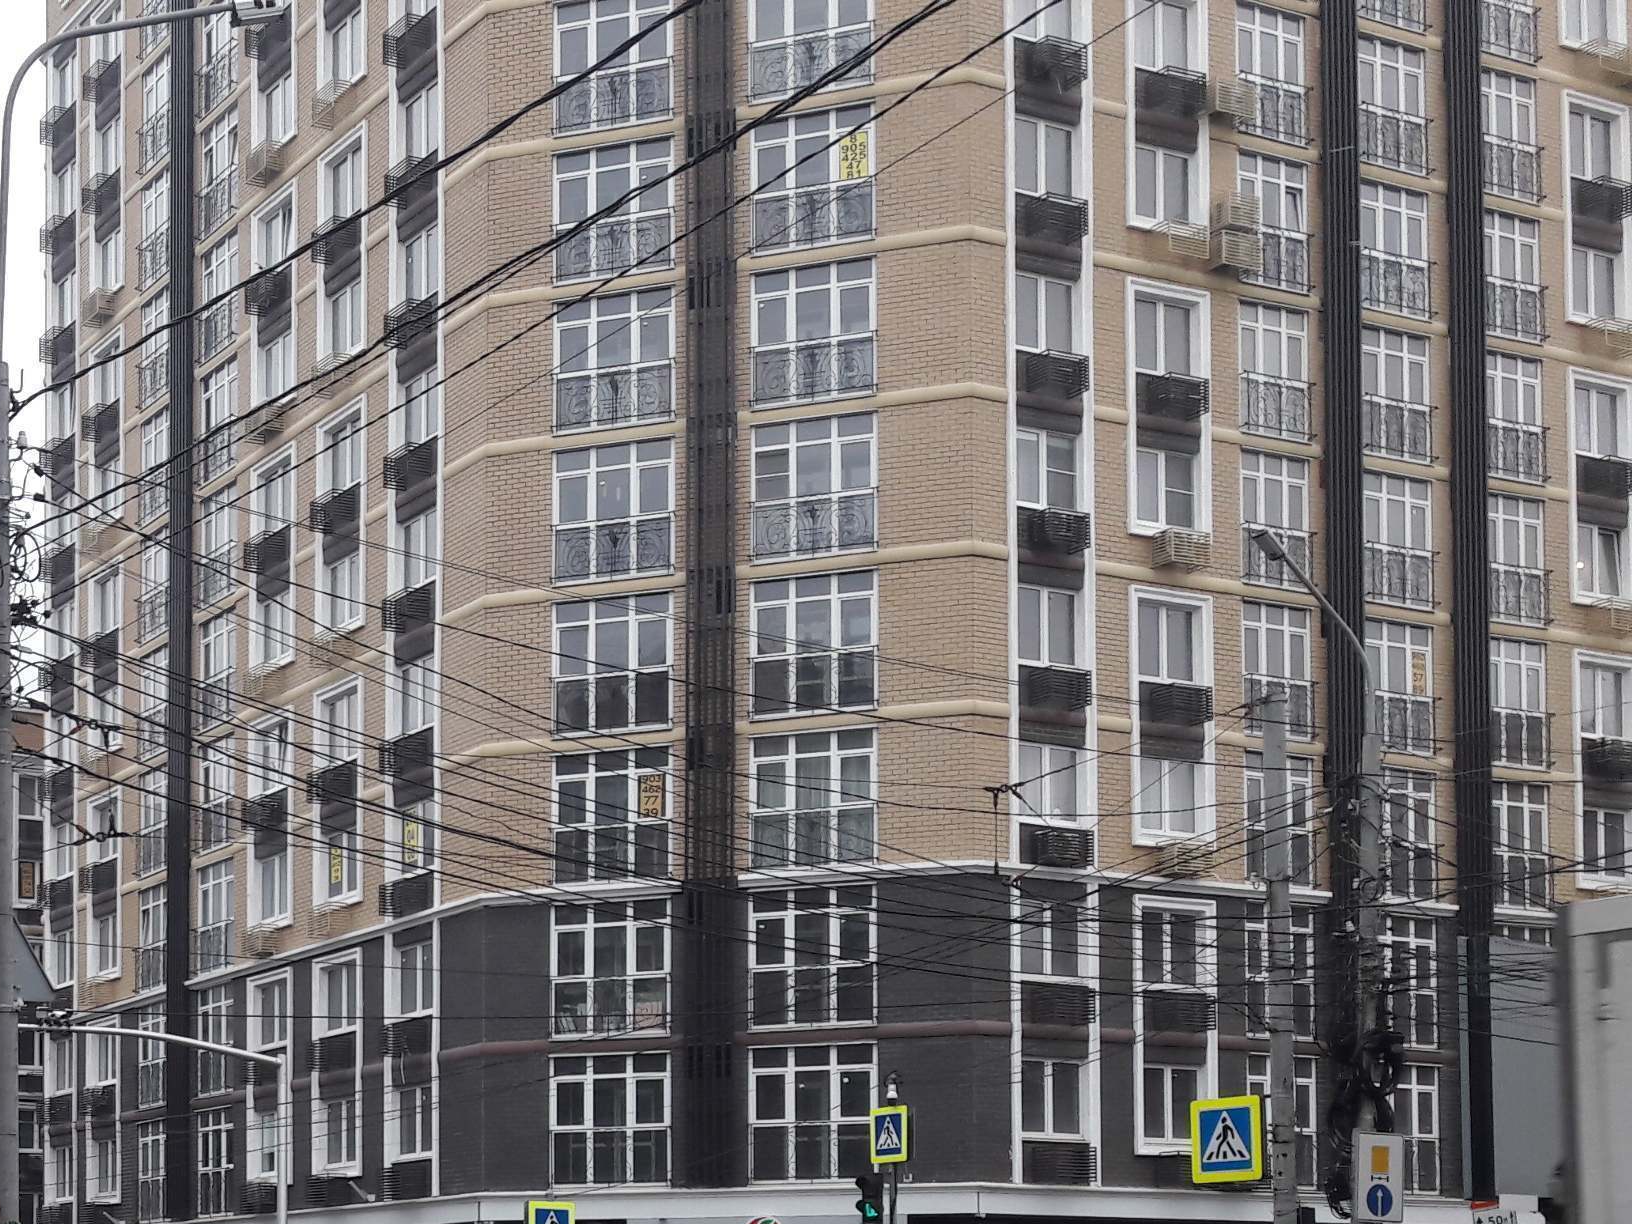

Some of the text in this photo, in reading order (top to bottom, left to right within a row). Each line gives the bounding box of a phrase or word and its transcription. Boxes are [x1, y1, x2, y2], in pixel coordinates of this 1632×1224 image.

[841, 142, 866, 153] 905
[841, 151, 866, 161] 425
[846, 160, 861, 169] 47
[644, 796, 659, 805] 77
